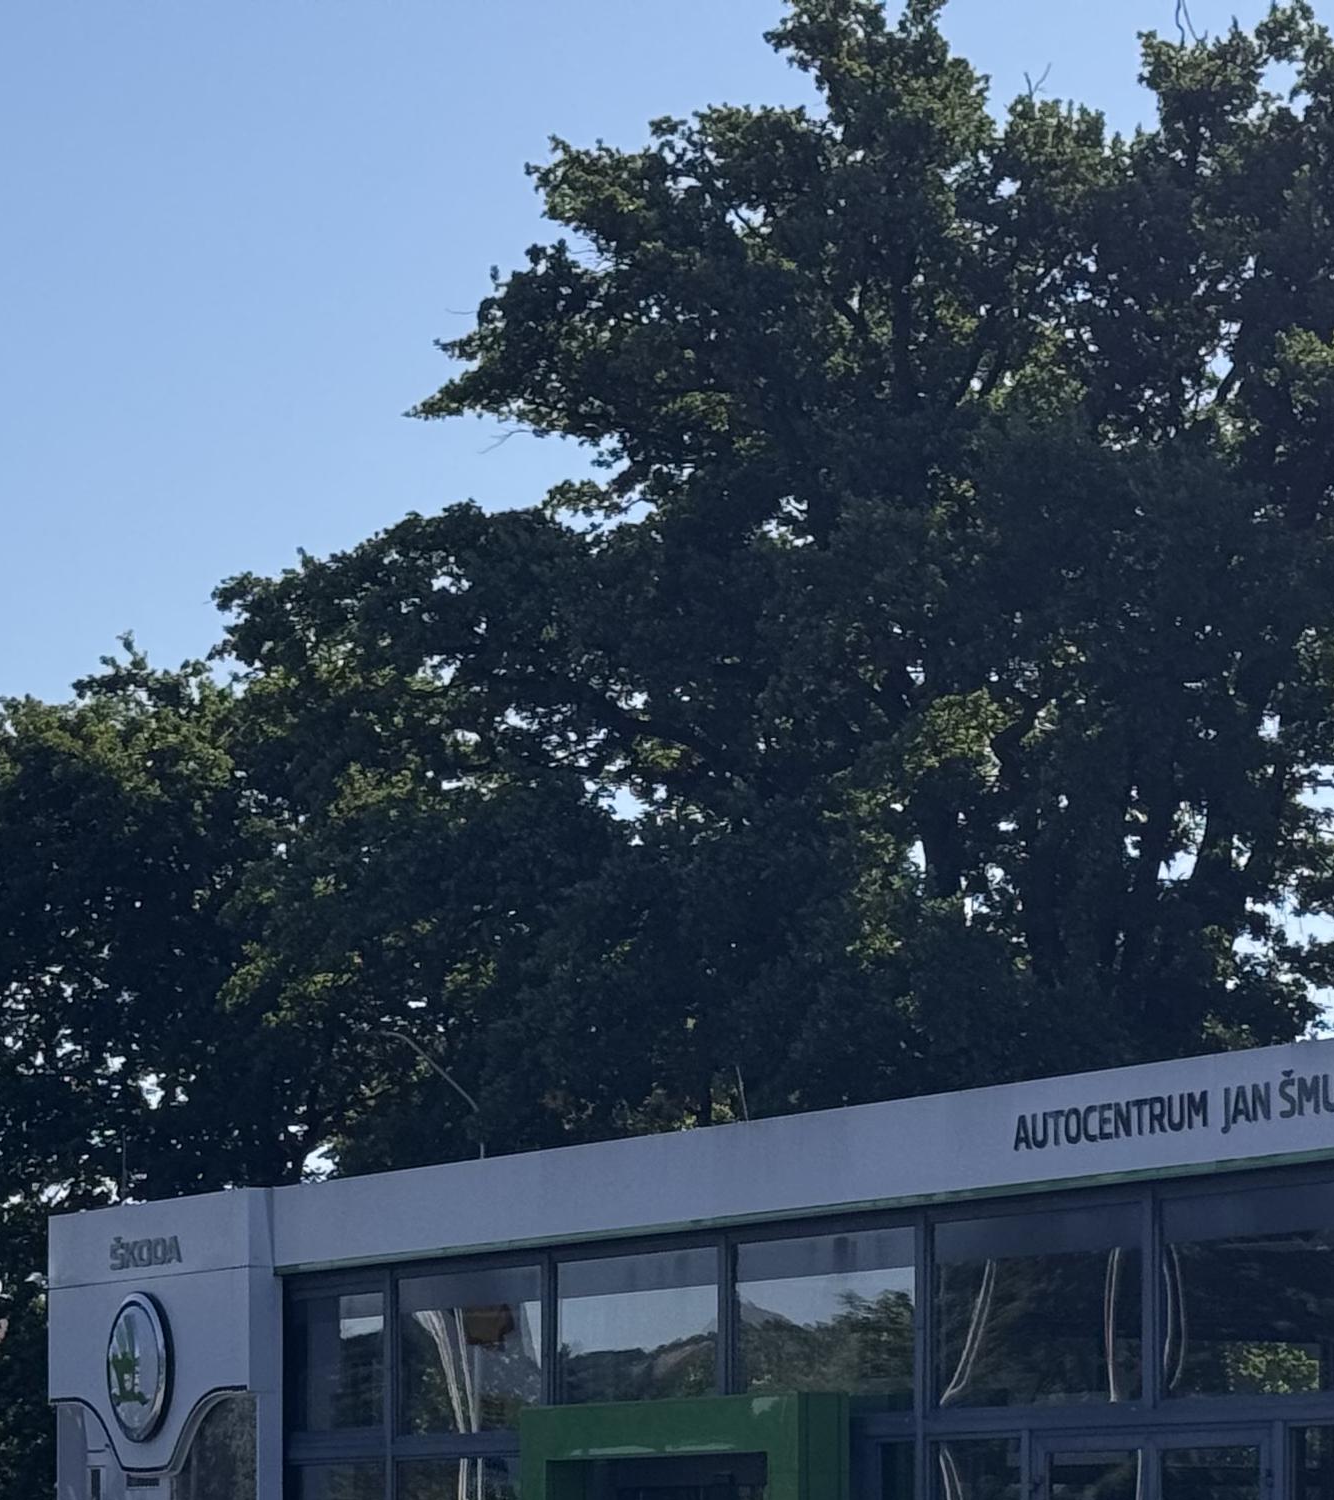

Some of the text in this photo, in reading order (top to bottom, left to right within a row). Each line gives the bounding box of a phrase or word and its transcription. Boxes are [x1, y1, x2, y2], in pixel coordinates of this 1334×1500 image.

[1013, 1090, 1209, 1152] AUTOCENTRUM
[1220, 1081, 1272, 1134] JAN
[109, 1235, 183, 1271] ŠKODA
